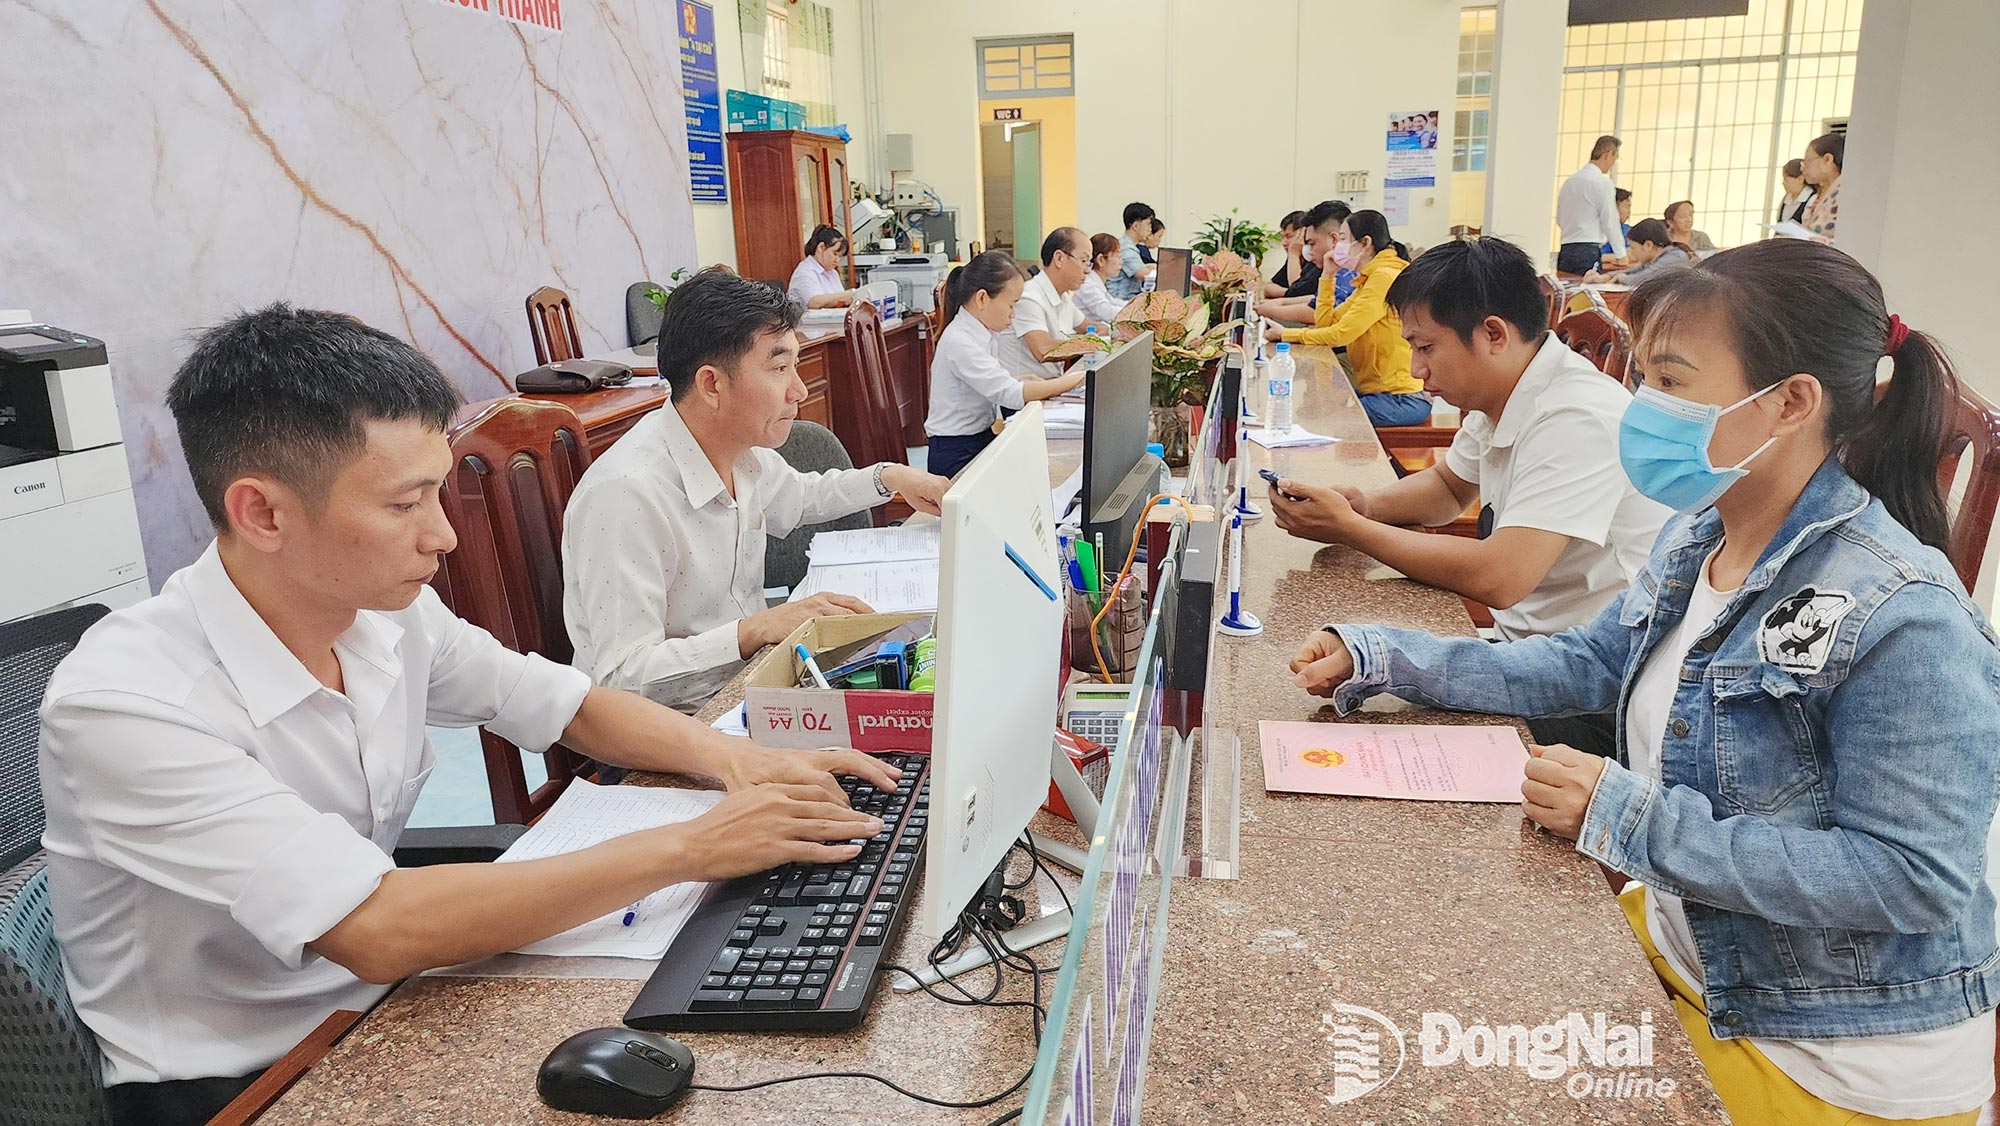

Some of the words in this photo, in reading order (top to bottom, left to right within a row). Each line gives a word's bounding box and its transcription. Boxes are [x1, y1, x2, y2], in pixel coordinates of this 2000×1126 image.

[996, 110, 1012, 119] WC
[14, 482, 46, 495] Canon
[886, 708, 910, 716] expert
[768, 717, 793, 730] A4
[802, 712, 832, 731] 70
[857, 714, 933, 735] natural
